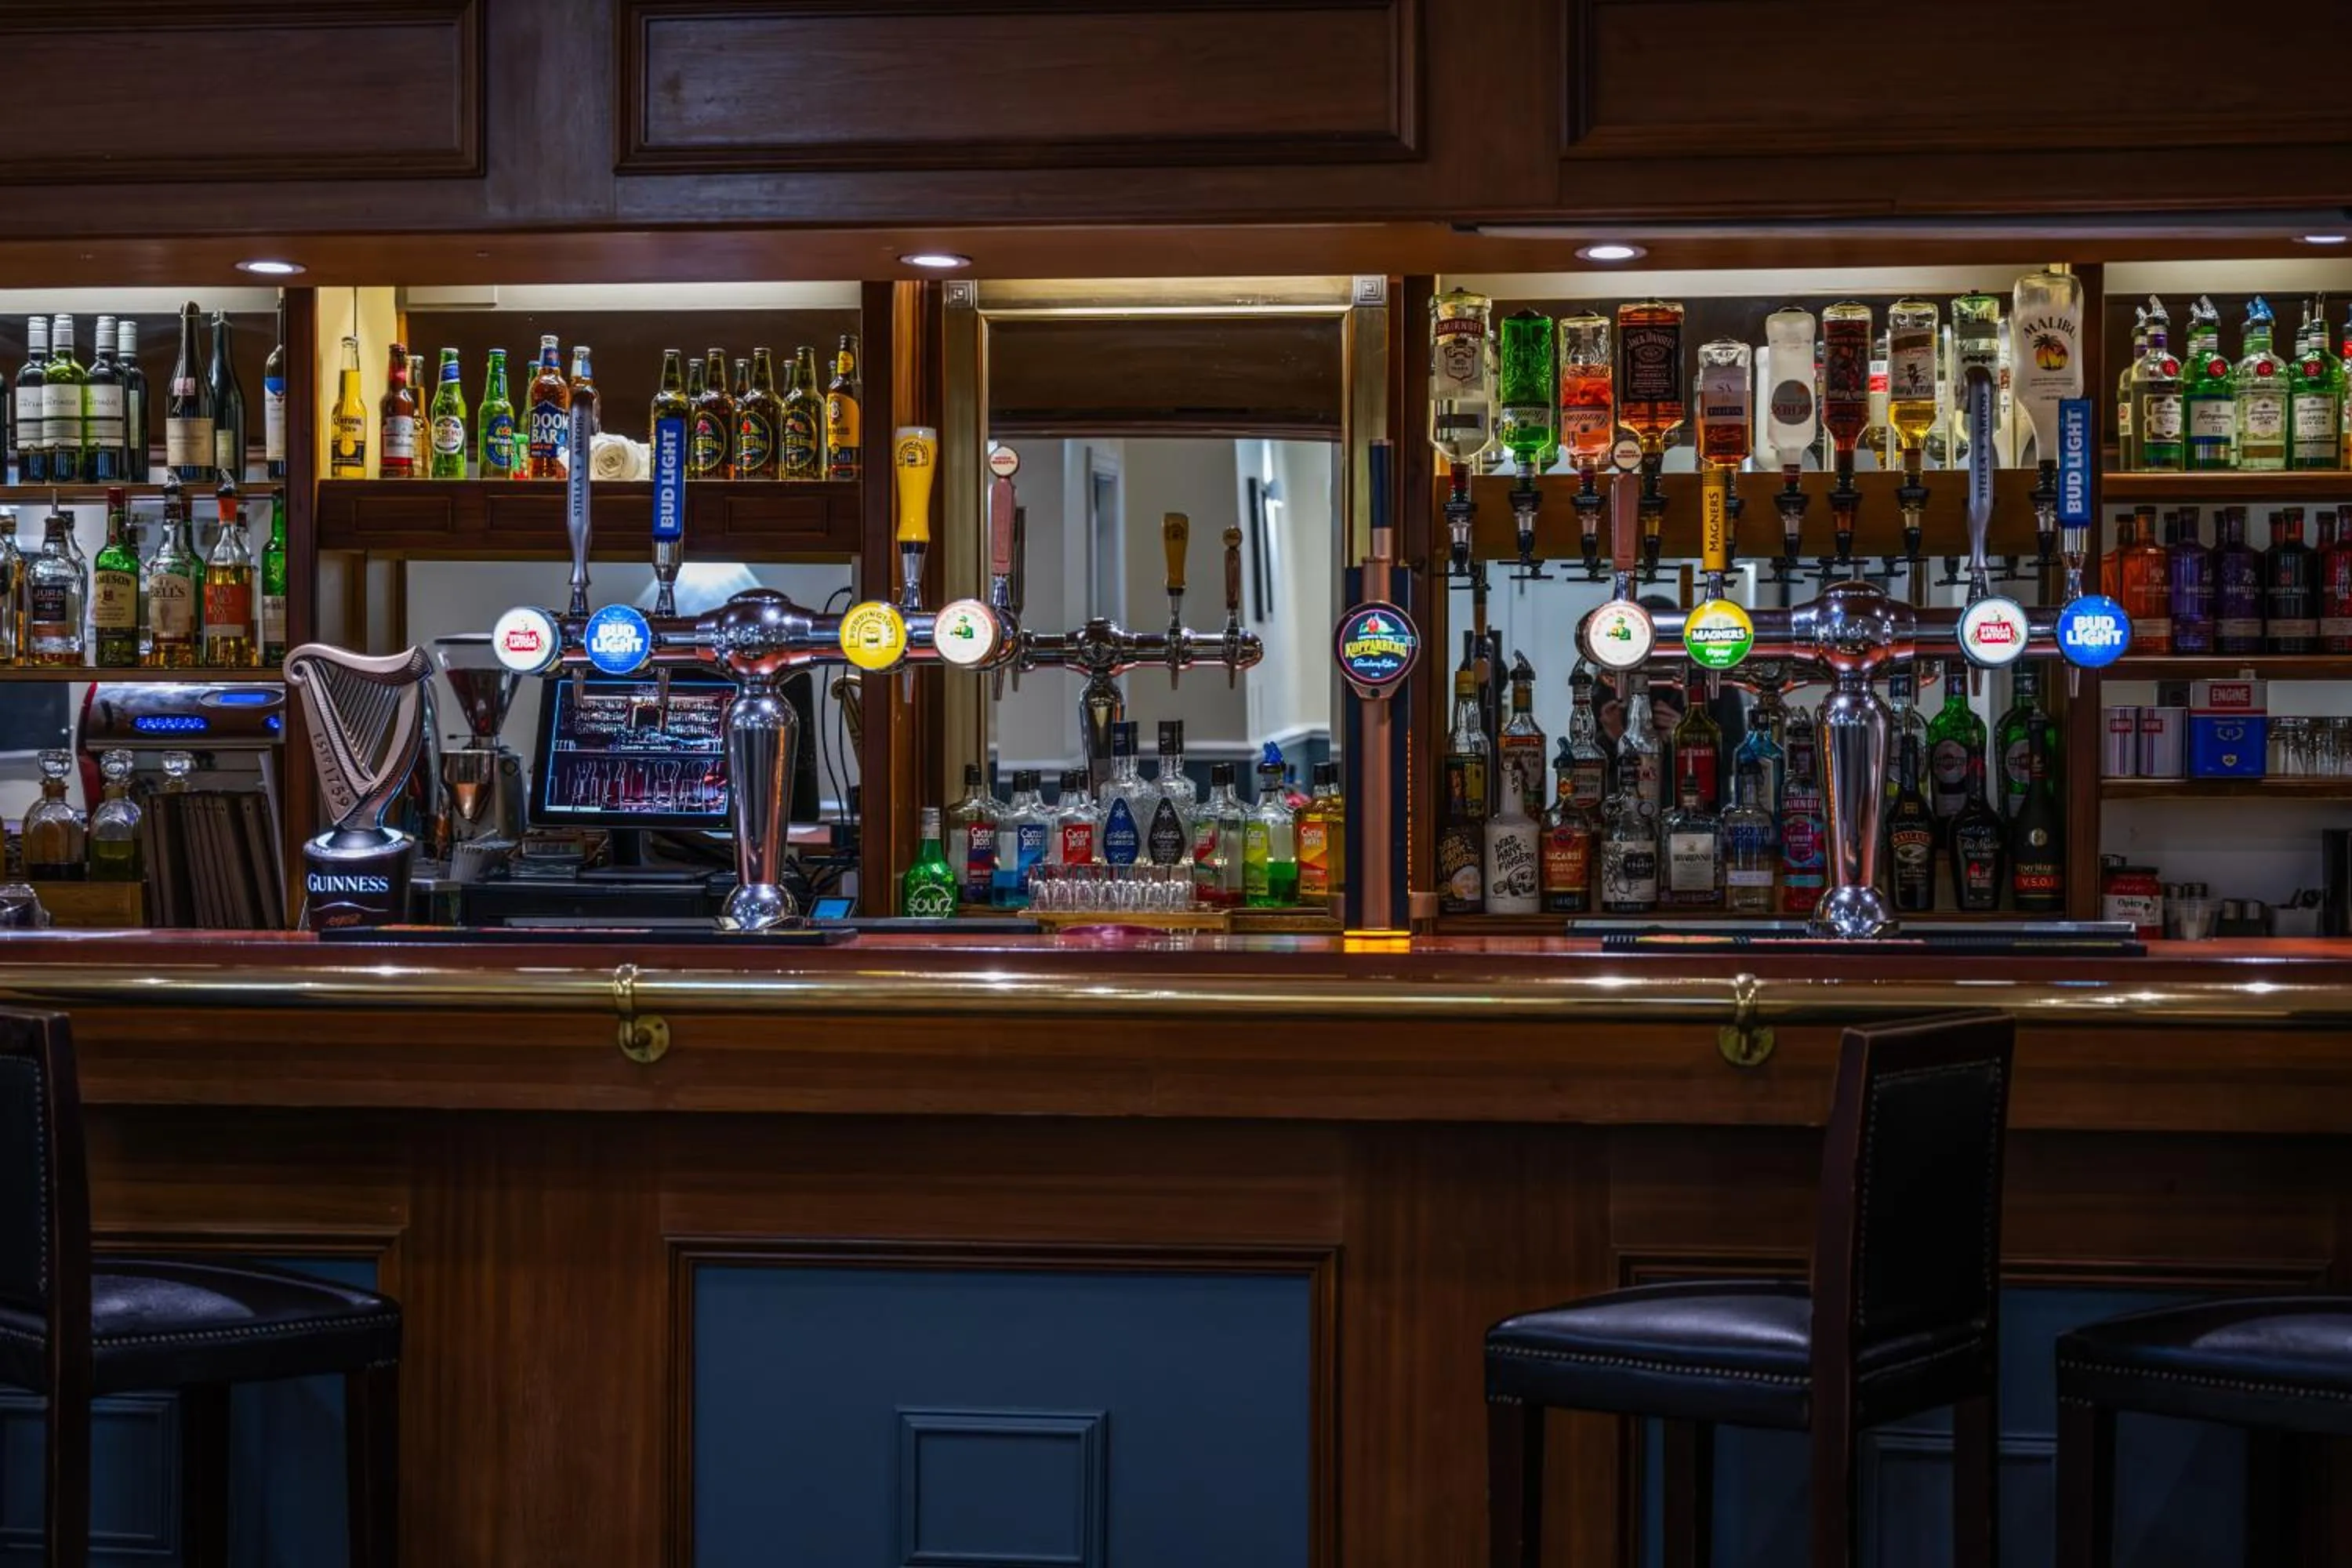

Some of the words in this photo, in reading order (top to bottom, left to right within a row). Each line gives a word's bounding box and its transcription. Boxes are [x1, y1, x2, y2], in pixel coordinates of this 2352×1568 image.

[1436, 319, 1483, 336] SMIRNOFF
[2024, 316, 2076, 339] MALIBU
[532, 429, 559, 445] BAR
[2066, 410, 2083, 468] LIGHT
[661, 429, 677, 486] LIGHT
[2066, 471, 2083, 514] BUD
[660, 488, 675, 528] BUD
[1709, 492, 1719, 552] MAGNERS
[597, 623, 637, 637] BUD
[2073, 615, 2116, 630] BUD
[1692, 627, 1746, 641] MAGNERS
[2066, 630, 2123, 645] LIGHT
[591, 636, 644, 653] LIGHT
[2212, 684, 2249, 702] ENGINE
[324, 768, 349, 808] 1759
[307, 871, 390, 892] GUINNESS
